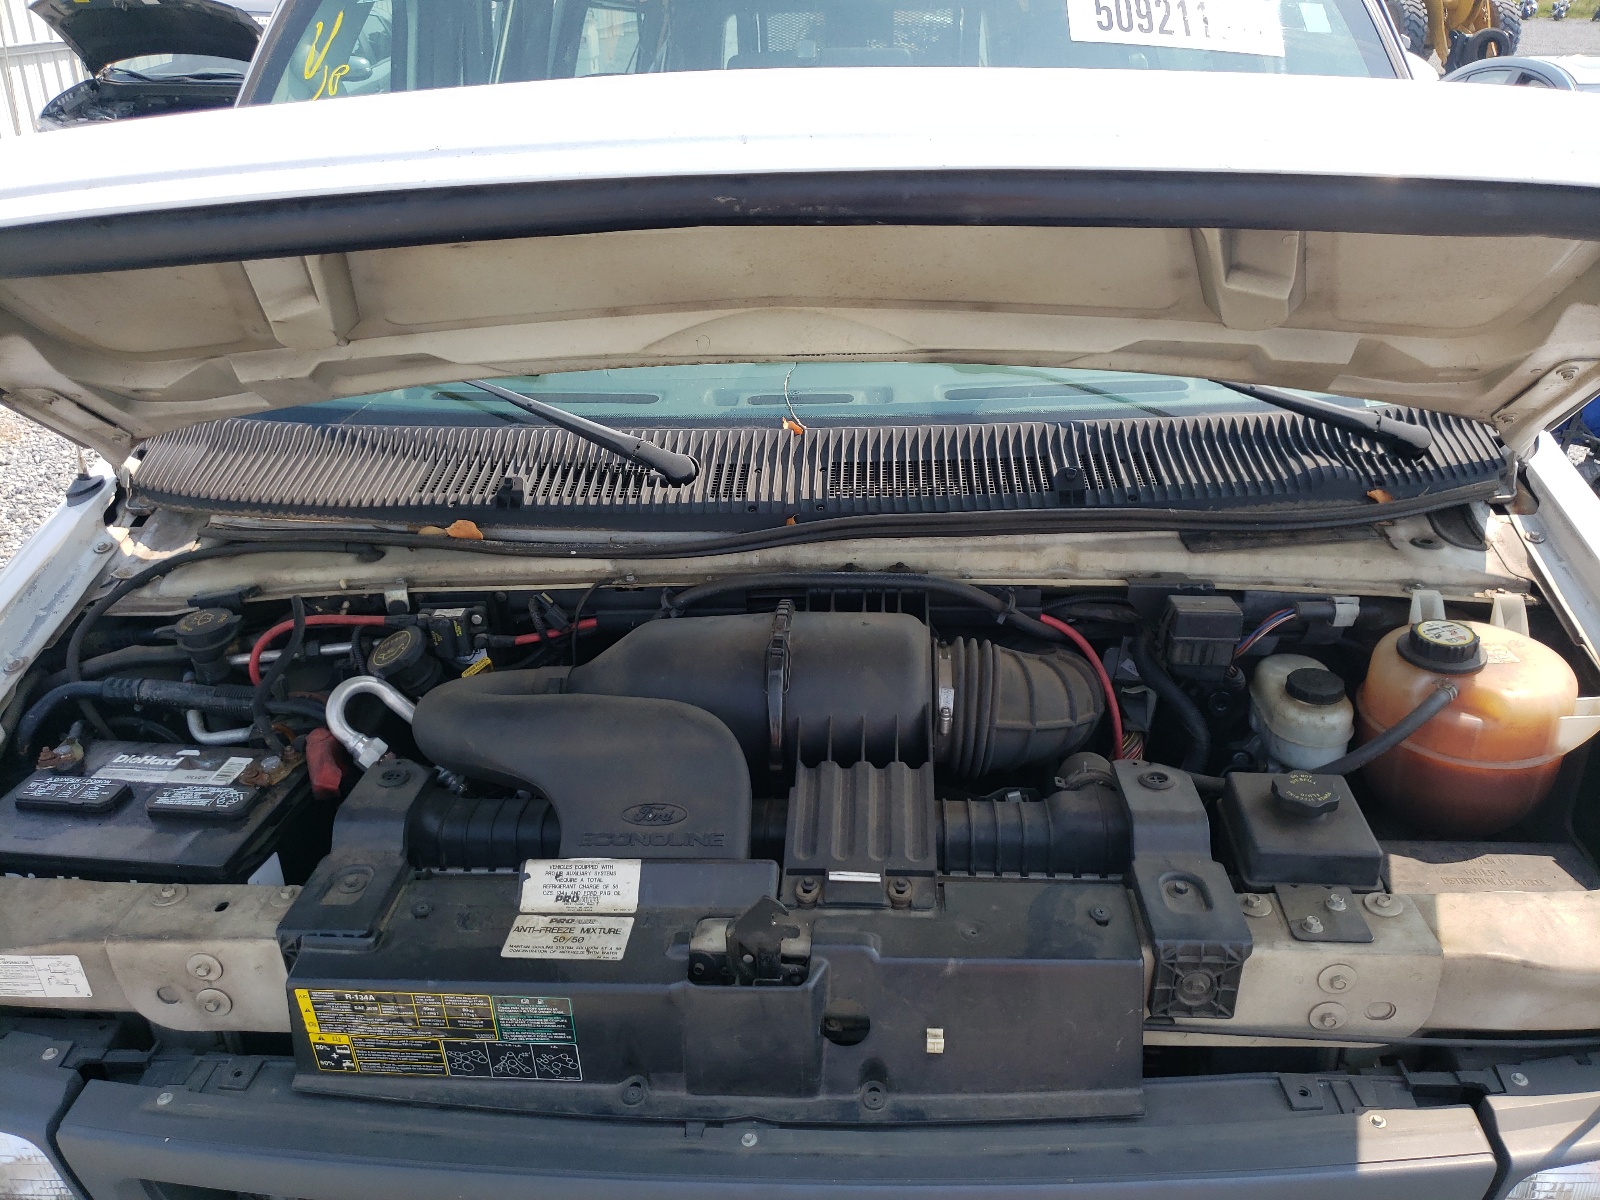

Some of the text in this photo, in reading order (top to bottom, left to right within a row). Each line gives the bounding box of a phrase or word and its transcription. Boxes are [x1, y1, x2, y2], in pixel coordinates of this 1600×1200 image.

[112, 754, 185, 766] DieHard
[578, 832, 725, 847] ECONOLINE
[512, 926, 622, 935] ANTI-FREEZE MIXTURE
[552, 936, 585, 944] 50/50
[344, 993, 376, 1001] R-134A
